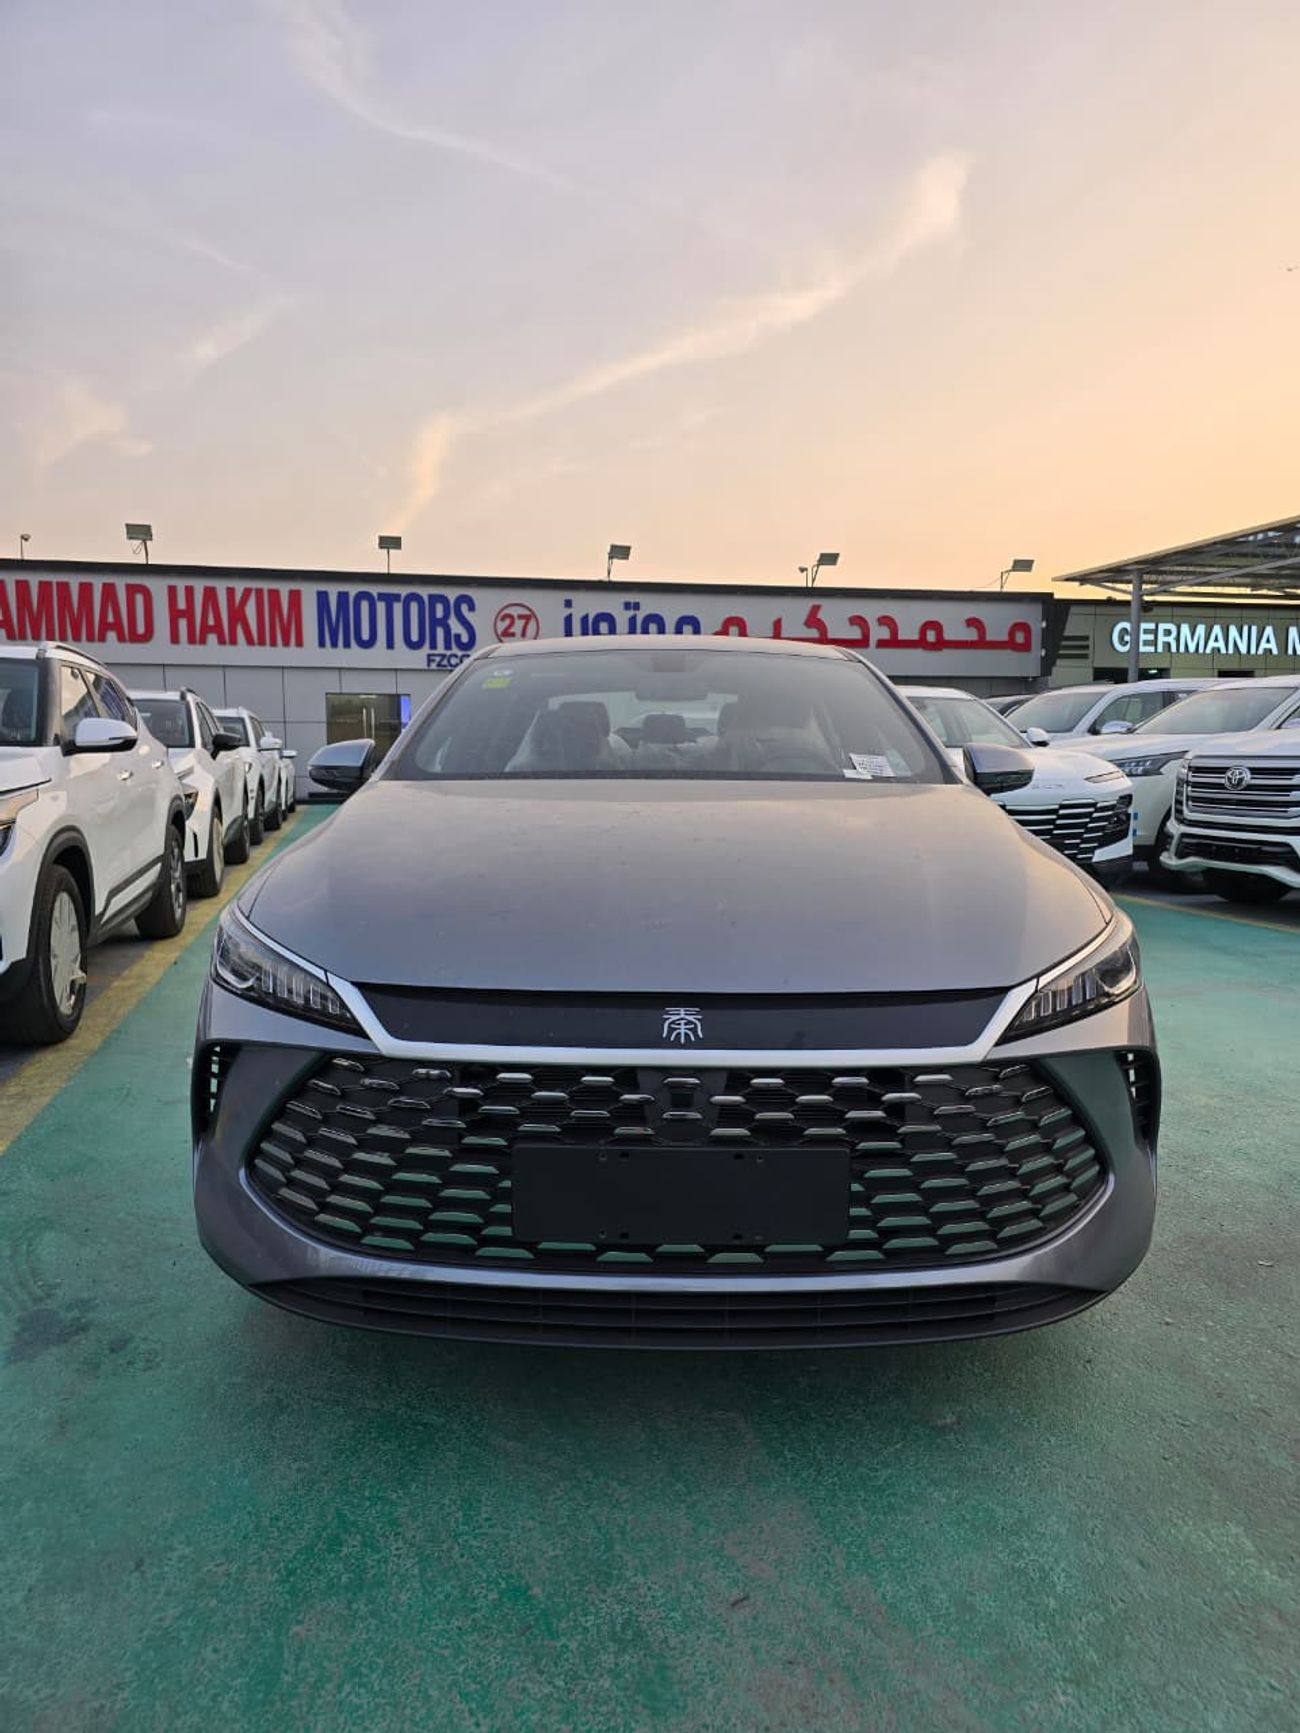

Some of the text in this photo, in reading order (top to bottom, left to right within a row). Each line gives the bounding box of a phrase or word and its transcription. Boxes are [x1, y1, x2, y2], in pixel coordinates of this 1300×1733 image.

[167, 585, 304, 647] HAKIM
[316, 590, 477, 651] MOTORS
[500, 614, 532, 638] 27
[876, 615, 1031, 652] محمد
[1112, 621, 1279, 655] GERMANIA
